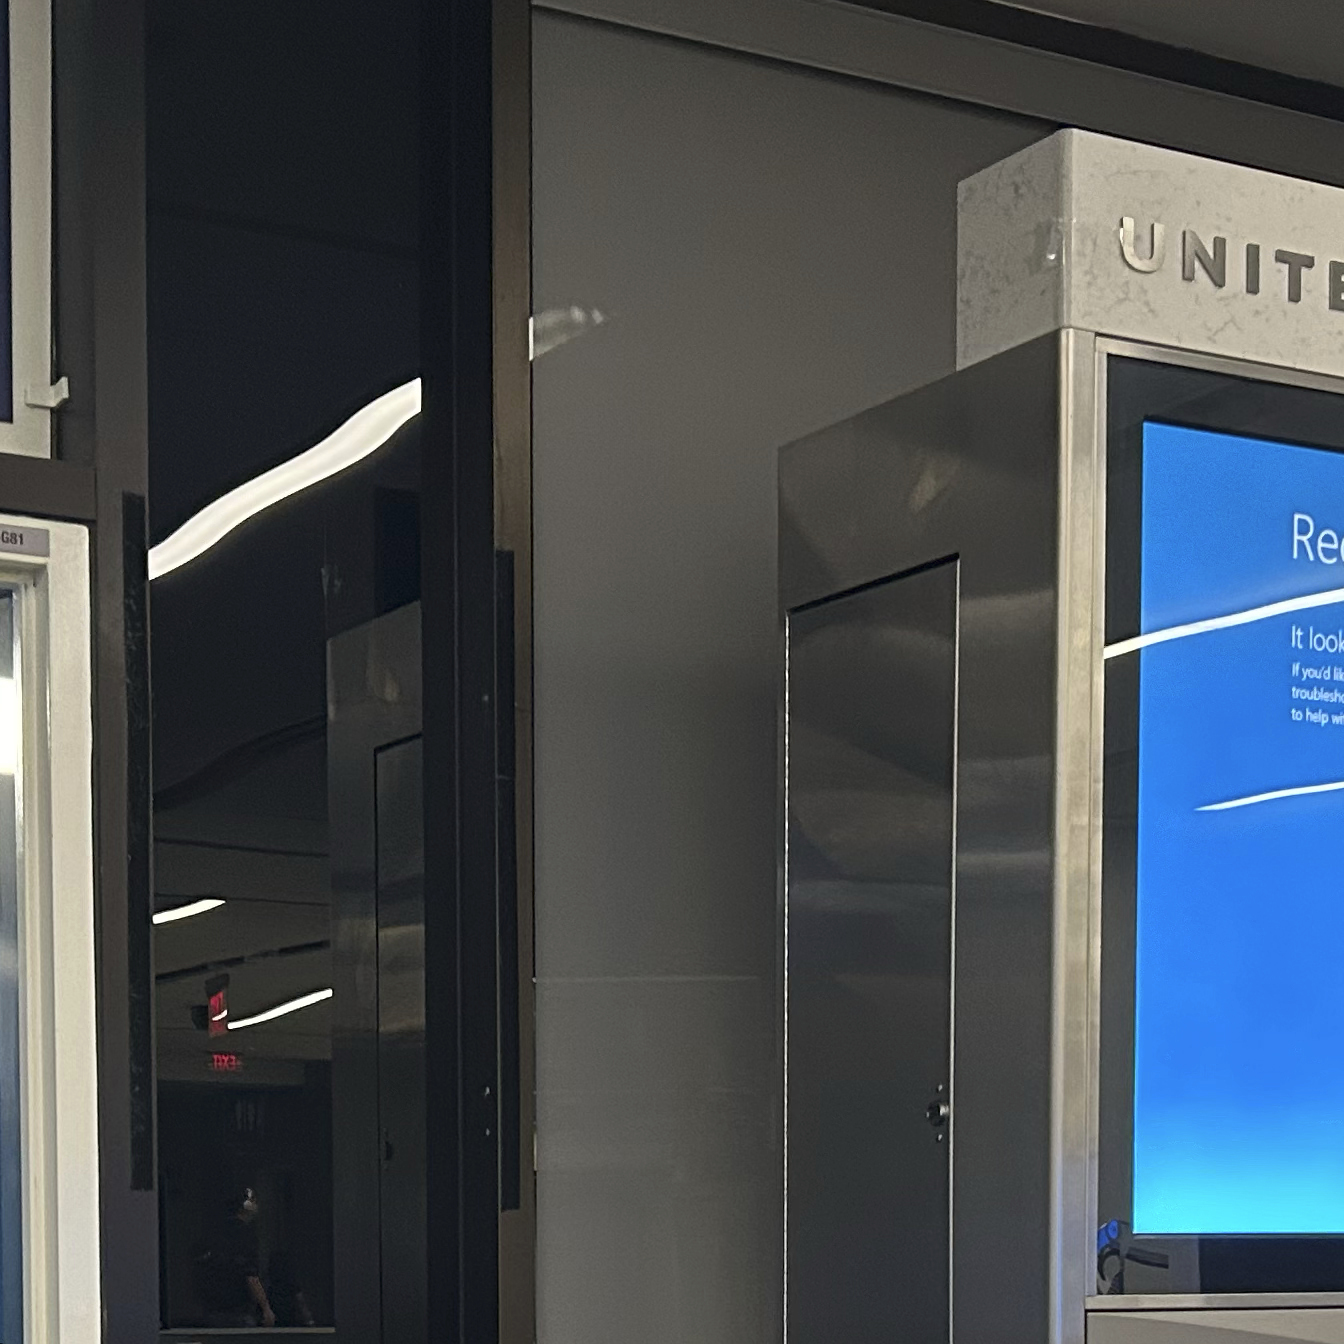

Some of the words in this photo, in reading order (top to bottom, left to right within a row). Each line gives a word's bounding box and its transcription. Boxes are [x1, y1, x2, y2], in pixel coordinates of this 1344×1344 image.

[1291, 624, 1304, 650] It
[1292, 662, 1301, 677] If
[1291, 708, 1303, 721] to
[1305, 708, 1329, 727] help
